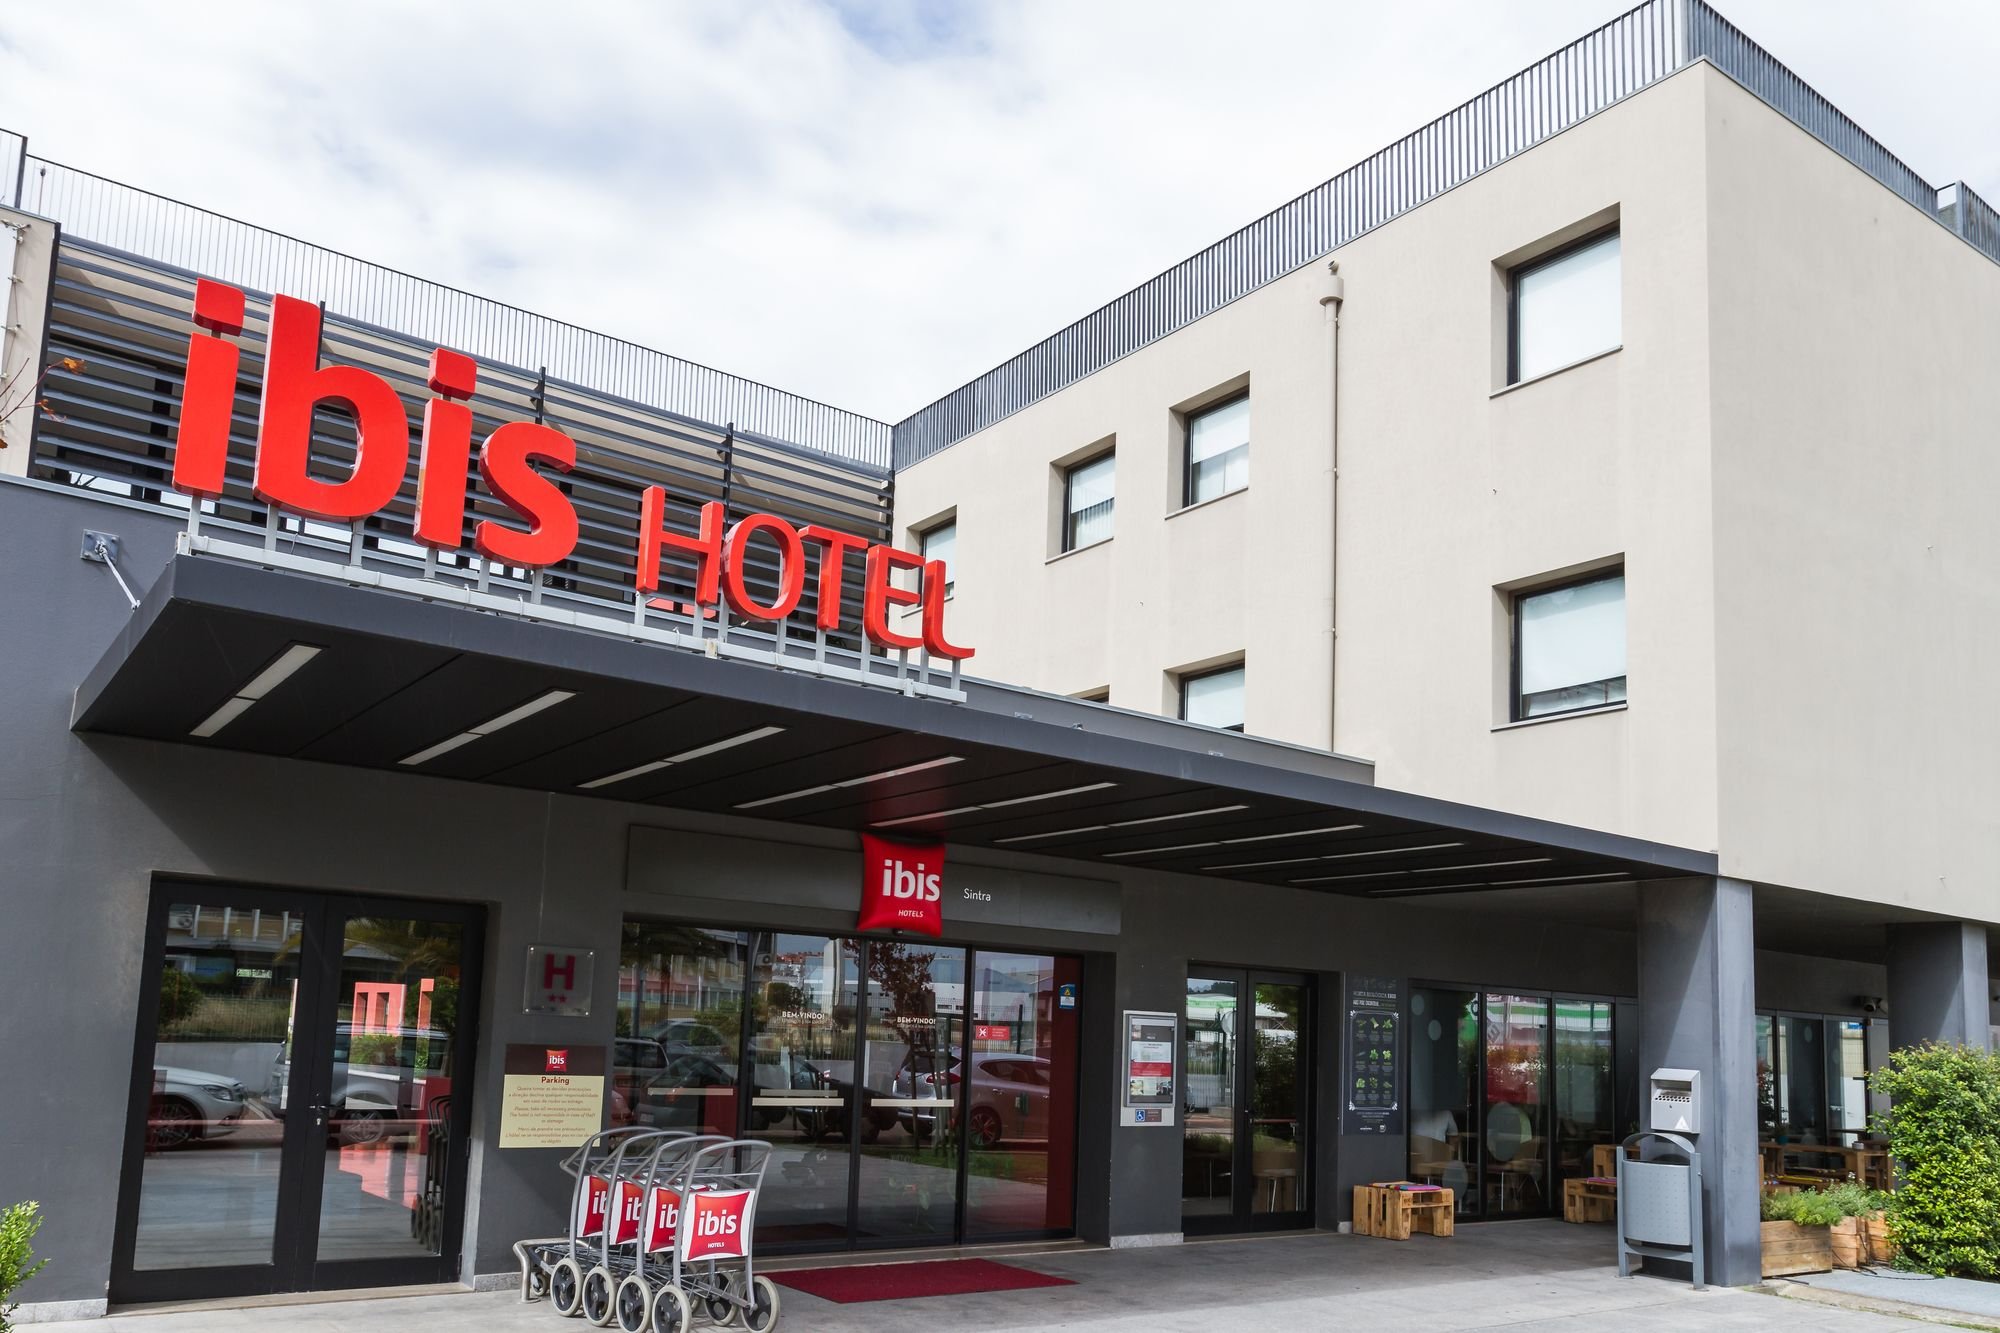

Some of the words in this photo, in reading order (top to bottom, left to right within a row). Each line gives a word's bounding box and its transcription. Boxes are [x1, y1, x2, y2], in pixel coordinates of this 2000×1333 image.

[172, 277, 579, 569] ibis
[636, 485, 975, 660] HOTEL
[883, 859, 940, 902] ibis
[963, 888, 991, 902] Sintra
[898, 909, 924, 918] HOTELS
[543, 953, 576, 991] H
[549, 1055, 565, 1065] ibis
[541, 1076, 570, 1085] Parking
[592, 1191, 607, 1215] ib
[626, 1197, 642, 1222] ib
[659, 1203, 679, 1229] ib
[697, 1209, 737, 1236] ibis
